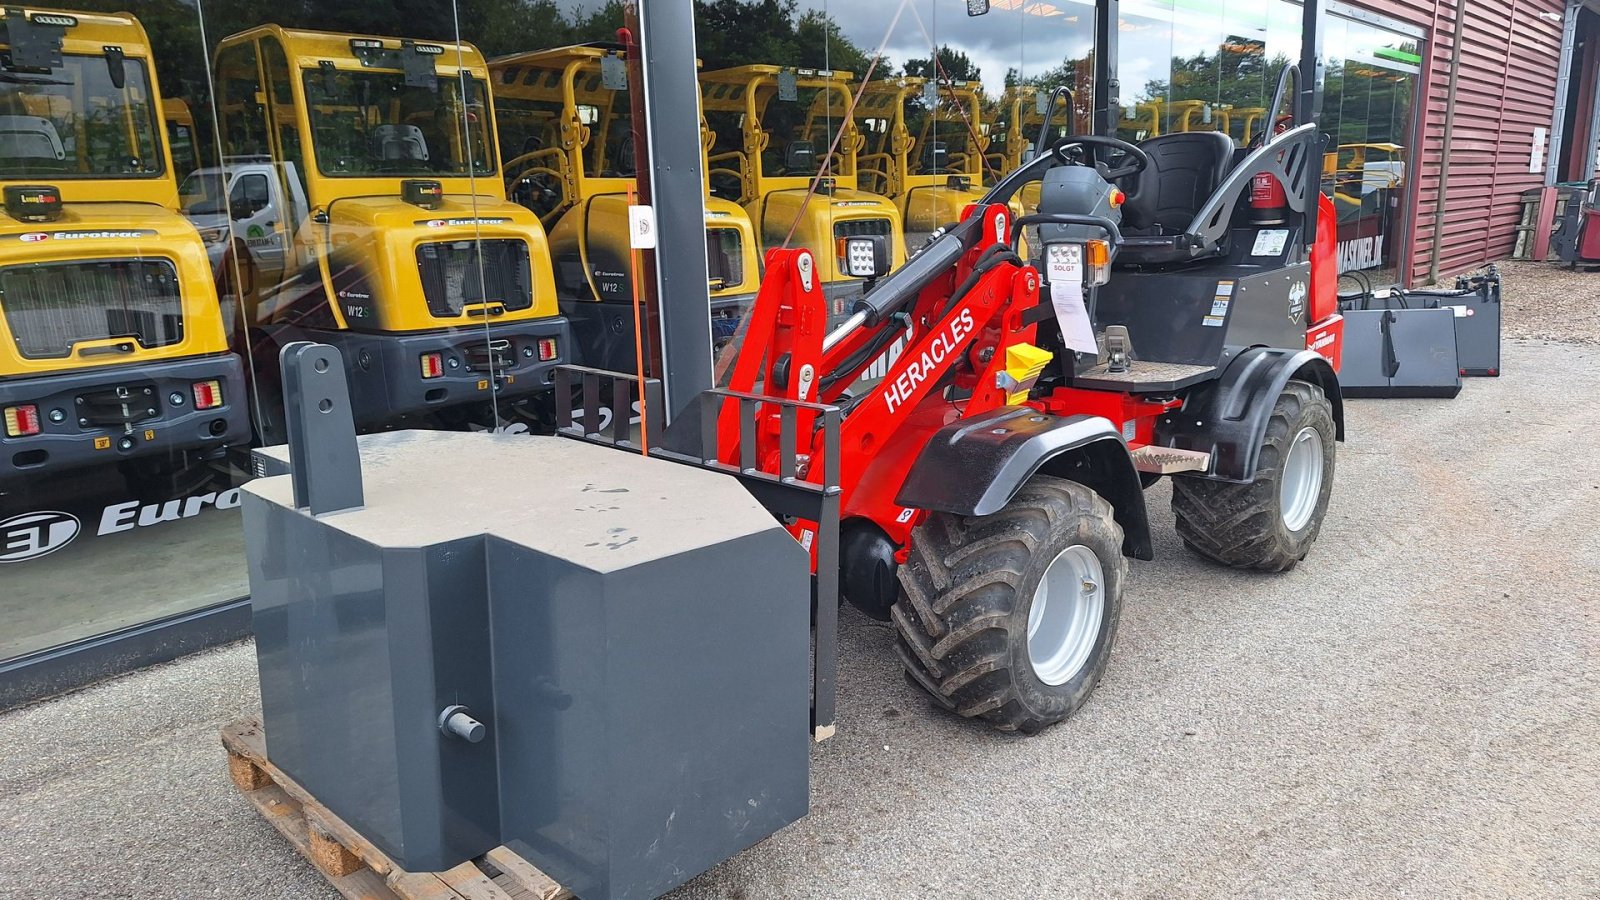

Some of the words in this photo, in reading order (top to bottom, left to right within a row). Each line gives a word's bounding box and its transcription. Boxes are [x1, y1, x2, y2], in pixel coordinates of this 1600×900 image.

[53, 231, 142, 240] Eurotrac
[1053, 264, 1075, 272] SOLGT
[346, 291, 370, 299] Eurotrac
[884, 307, 974, 415] HERACLES
